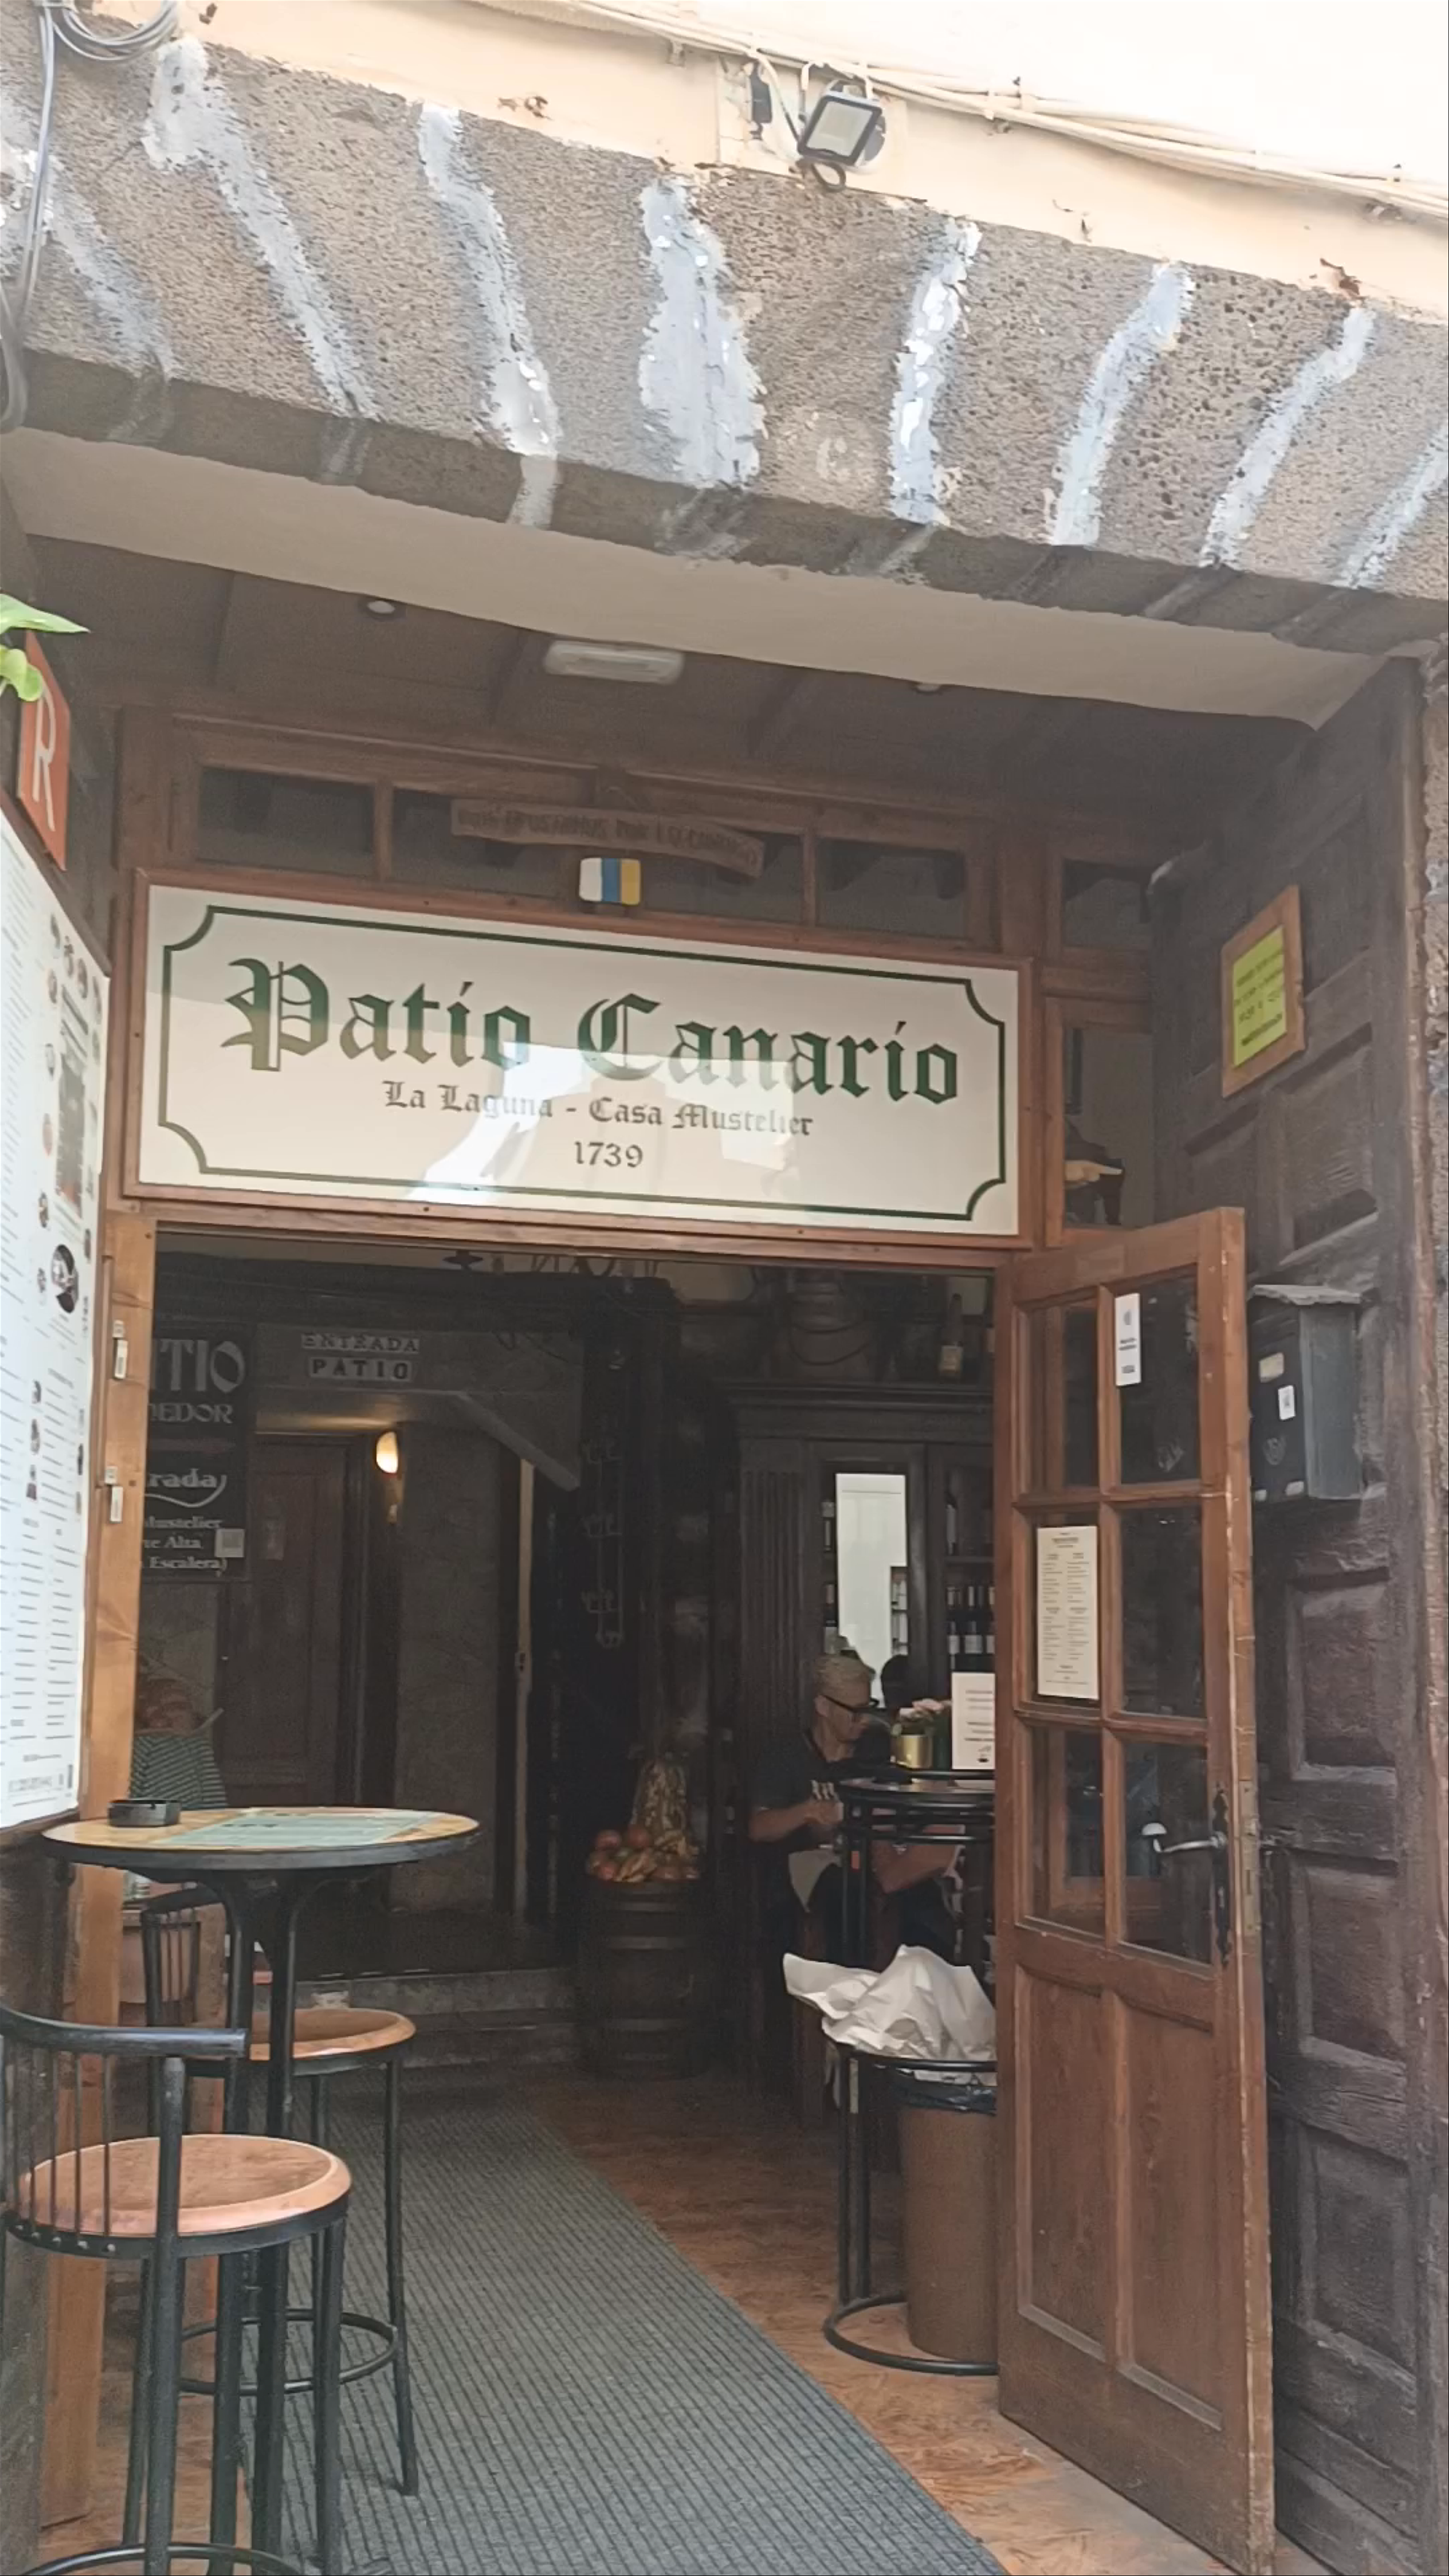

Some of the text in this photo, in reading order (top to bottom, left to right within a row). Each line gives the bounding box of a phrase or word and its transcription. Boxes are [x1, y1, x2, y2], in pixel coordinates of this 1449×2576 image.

[382, 1080, 426, 1109] La
[437, 1084, 553, 1119] Laguna
[589, 1097, 663, 1125] Casa
[671, 1103, 814, 1136] Mustelier
[574, 1141, 643, 1168] 1739
[303, 1332, 417, 1352] ENTRADA
[151, 1338, 245, 1393] TIO
[313, 1358, 408, 1379] PATIO
[148, 1402, 233, 1424] EDOR
[148, 1468, 217, 1488] rada
